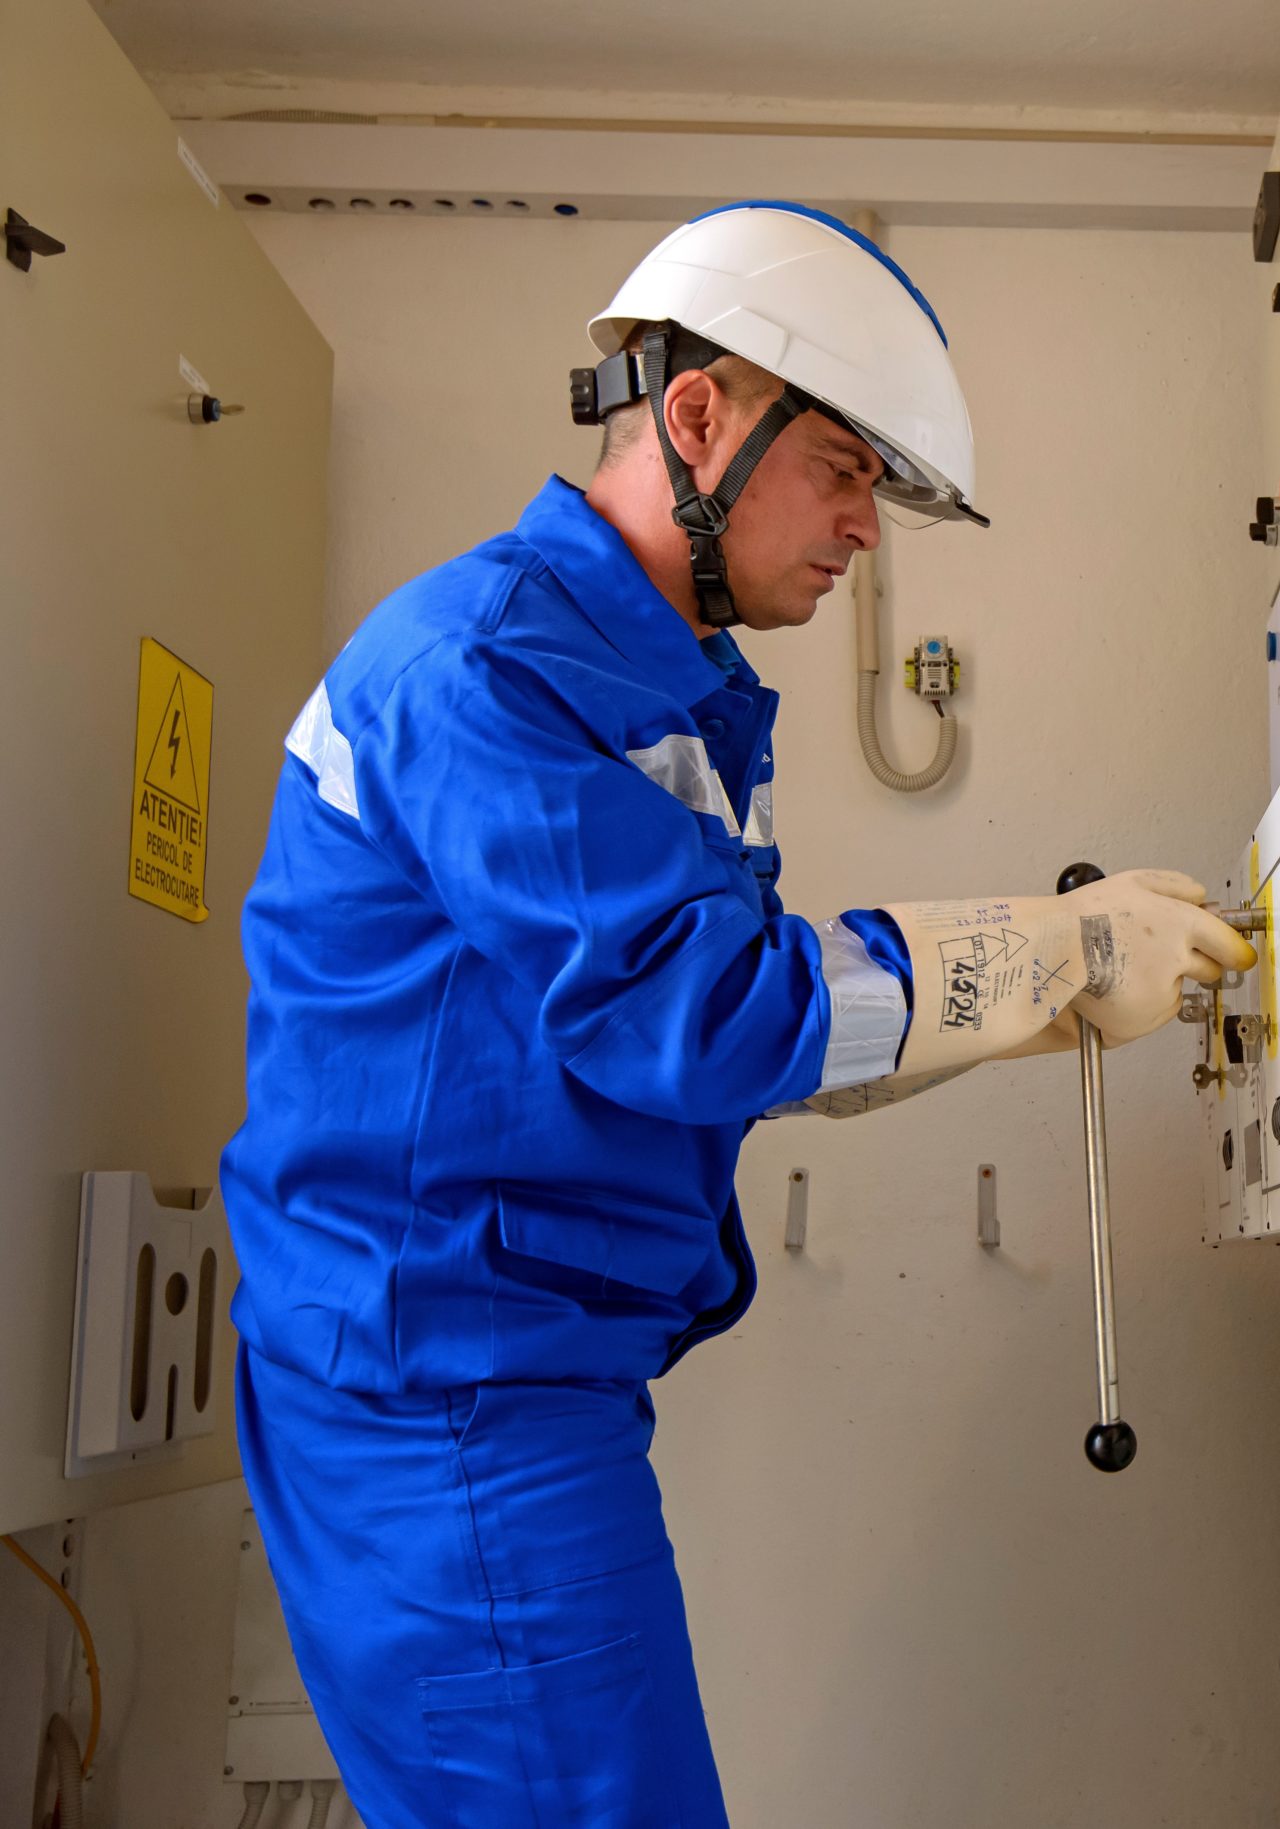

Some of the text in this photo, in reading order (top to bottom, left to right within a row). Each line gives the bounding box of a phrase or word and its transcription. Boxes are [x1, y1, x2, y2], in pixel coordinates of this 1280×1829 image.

[146, 831, 193, 874] PERICOL DE
[135, 858, 200, 908] ELECTROCUTARE
